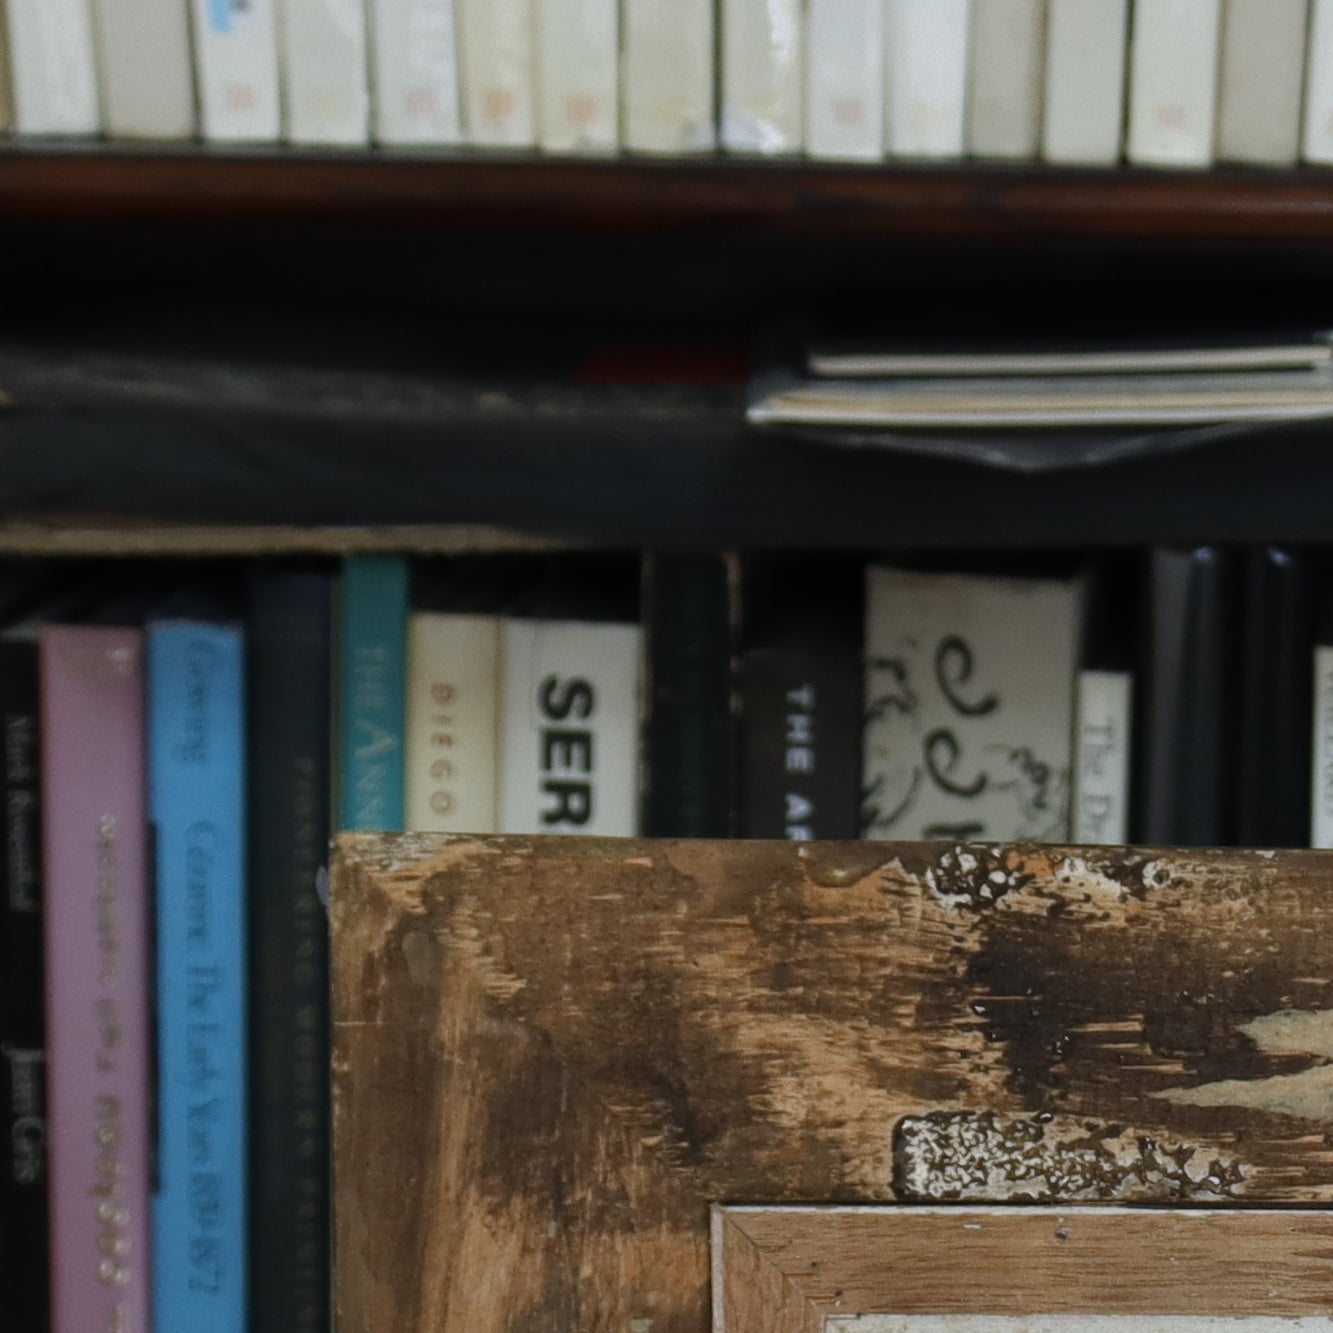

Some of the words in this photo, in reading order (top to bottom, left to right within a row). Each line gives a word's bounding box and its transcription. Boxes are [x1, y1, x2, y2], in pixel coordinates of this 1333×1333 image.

[430, 682, 457, 818] DIEGO
[538, 671, 596, 828] SER
[785, 683, 816, 774] THE
[10, 1116, 45, 1183] Gris
